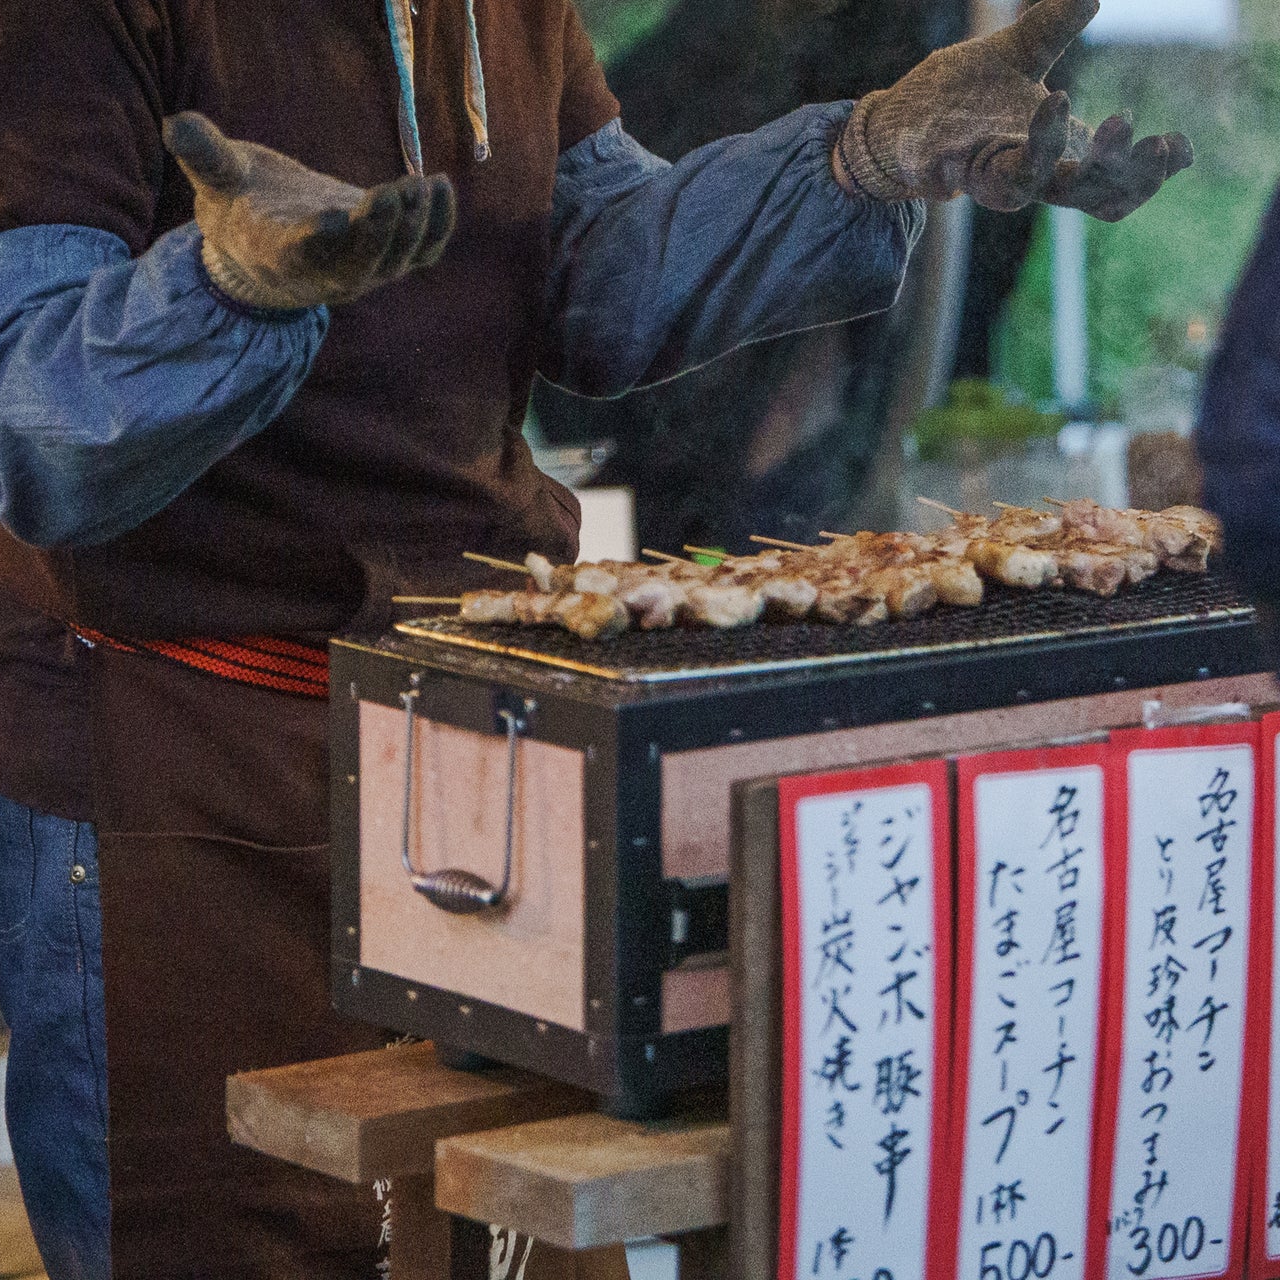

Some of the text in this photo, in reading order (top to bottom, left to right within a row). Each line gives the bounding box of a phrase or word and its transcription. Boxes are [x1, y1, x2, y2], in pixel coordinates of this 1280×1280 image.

[980, 860, 1030, 1164] たまごスープ
[1038, 784, 1086, 1136] 名古屋コーチン
